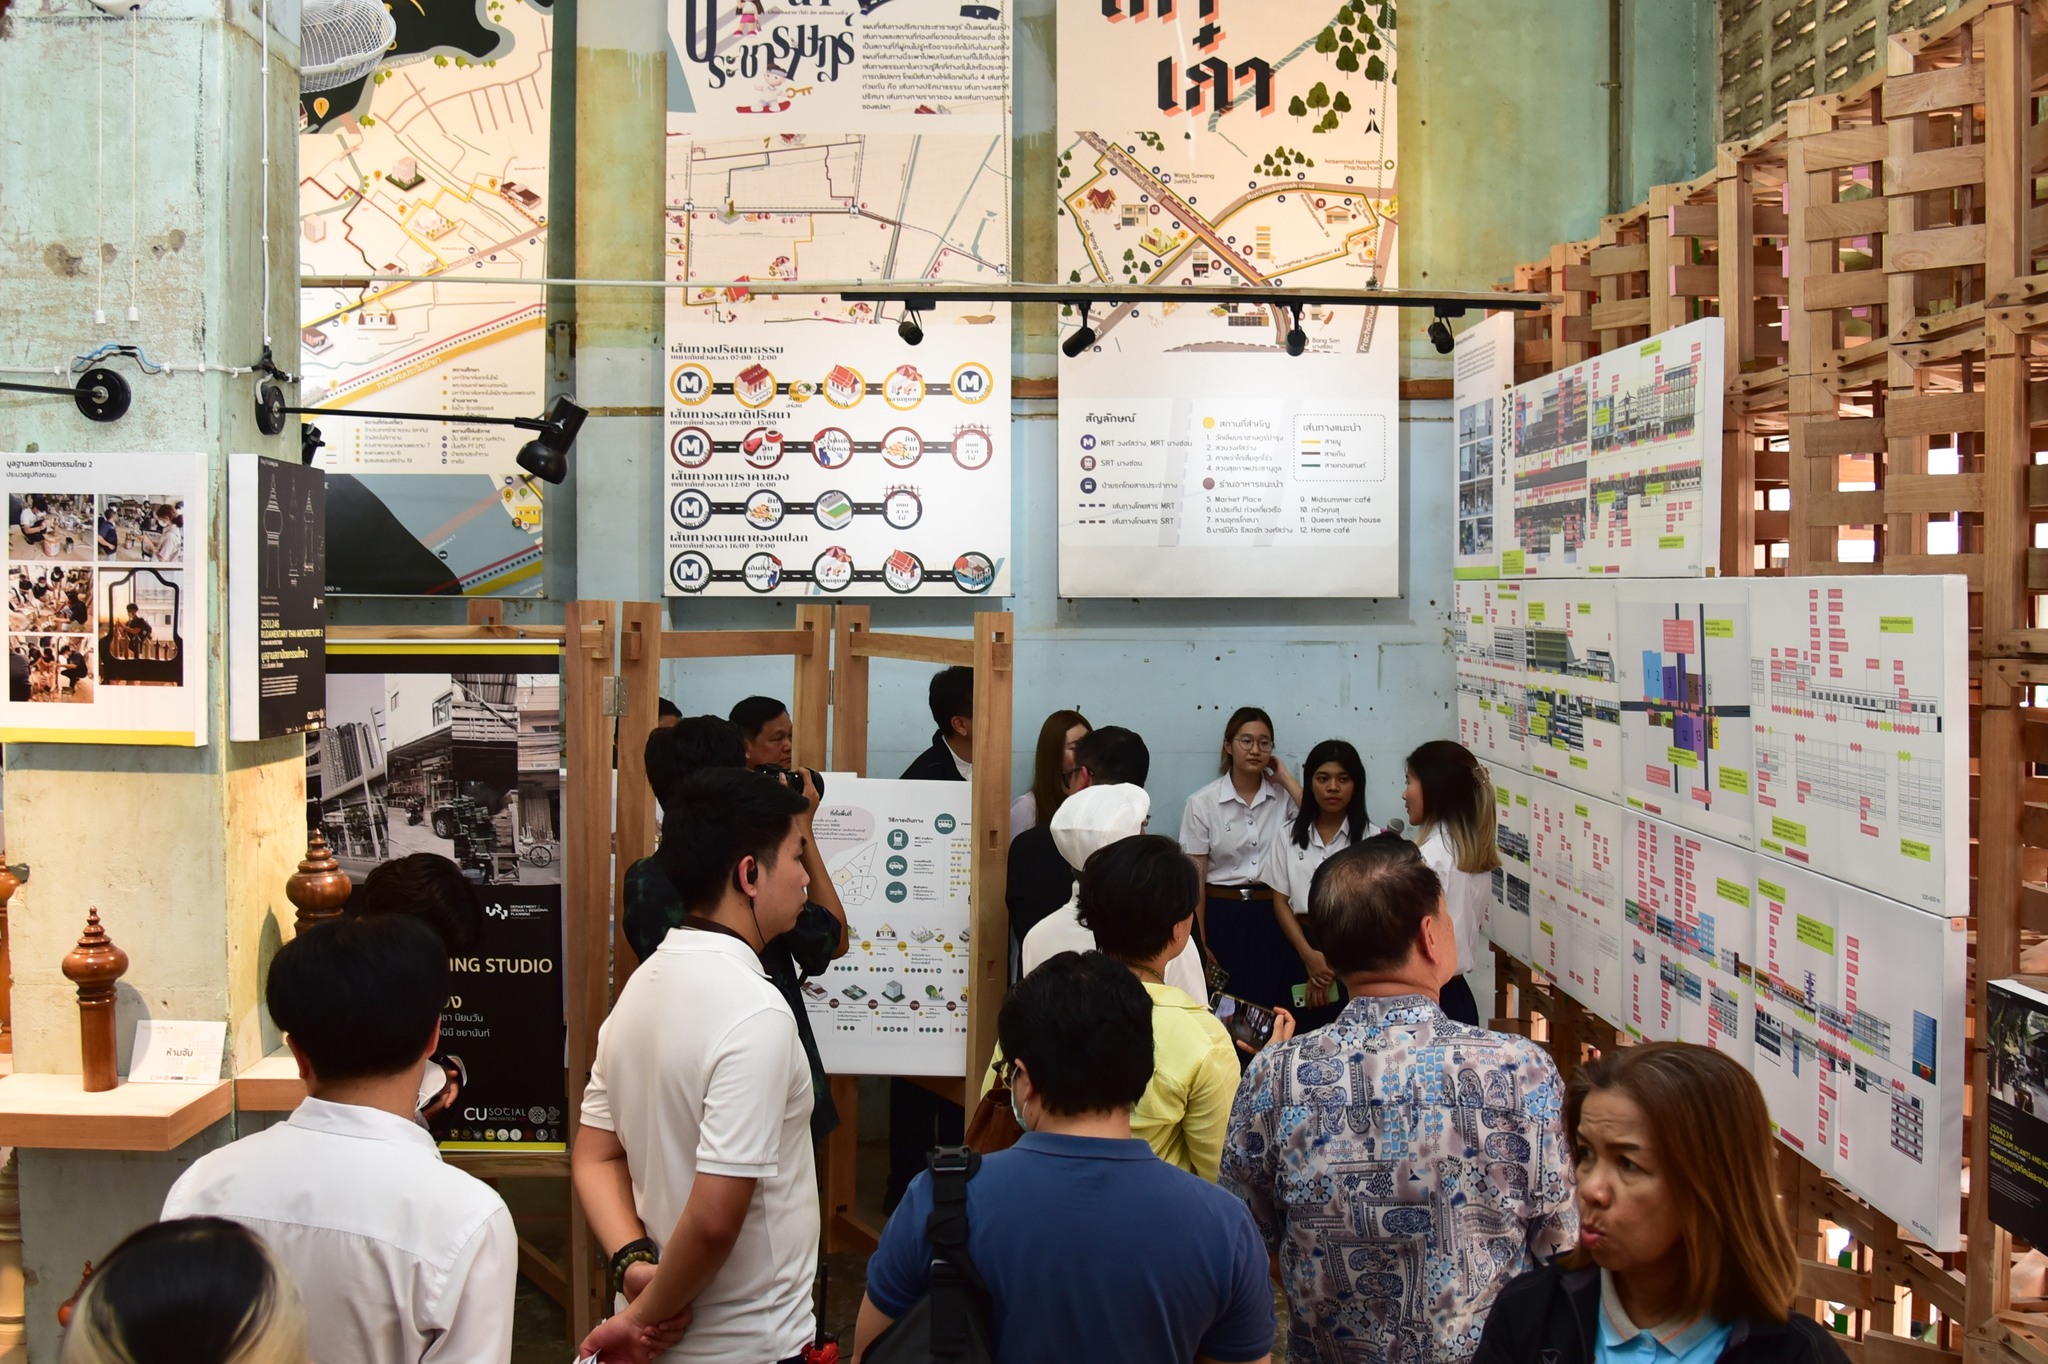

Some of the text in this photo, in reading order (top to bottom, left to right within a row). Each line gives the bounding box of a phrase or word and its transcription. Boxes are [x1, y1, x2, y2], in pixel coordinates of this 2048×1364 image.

[1173, 172, 1215, 180] Wong Sawang
[1089, 230, 1099, 250] Wong
[1097, 251, 1110, 279] Sawang
[1361, 306, 1375, 352] Prachachu
[671, 342, 784, 354] เส้นทางปริศนาธรรม
[670, 409, 792, 420] เส้นทางรสชาติปริศนา
[1085, 412, 1136, 425] สัญลักษณ์
[1303, 422, 1361, 432] เส้นทางแนะนำ
[6, 459, 87, 469] มูลฐานสถาปัตยกรรมไทย
[671, 470, 790, 481] เส้นทางทายราคาของ
[1219, 479, 1284, 489] ร้านอาหารแนะนำ
[1310, 516, 1334, 524] Queen
[670, 531, 808, 542] เส้นทางตามหาของแปลก
[449, 957, 553, 973] ING STUDIO
[166, 1047, 193, 1057] ห้ามจับ
[463, 1107, 526, 1121] CU SOCIAL
